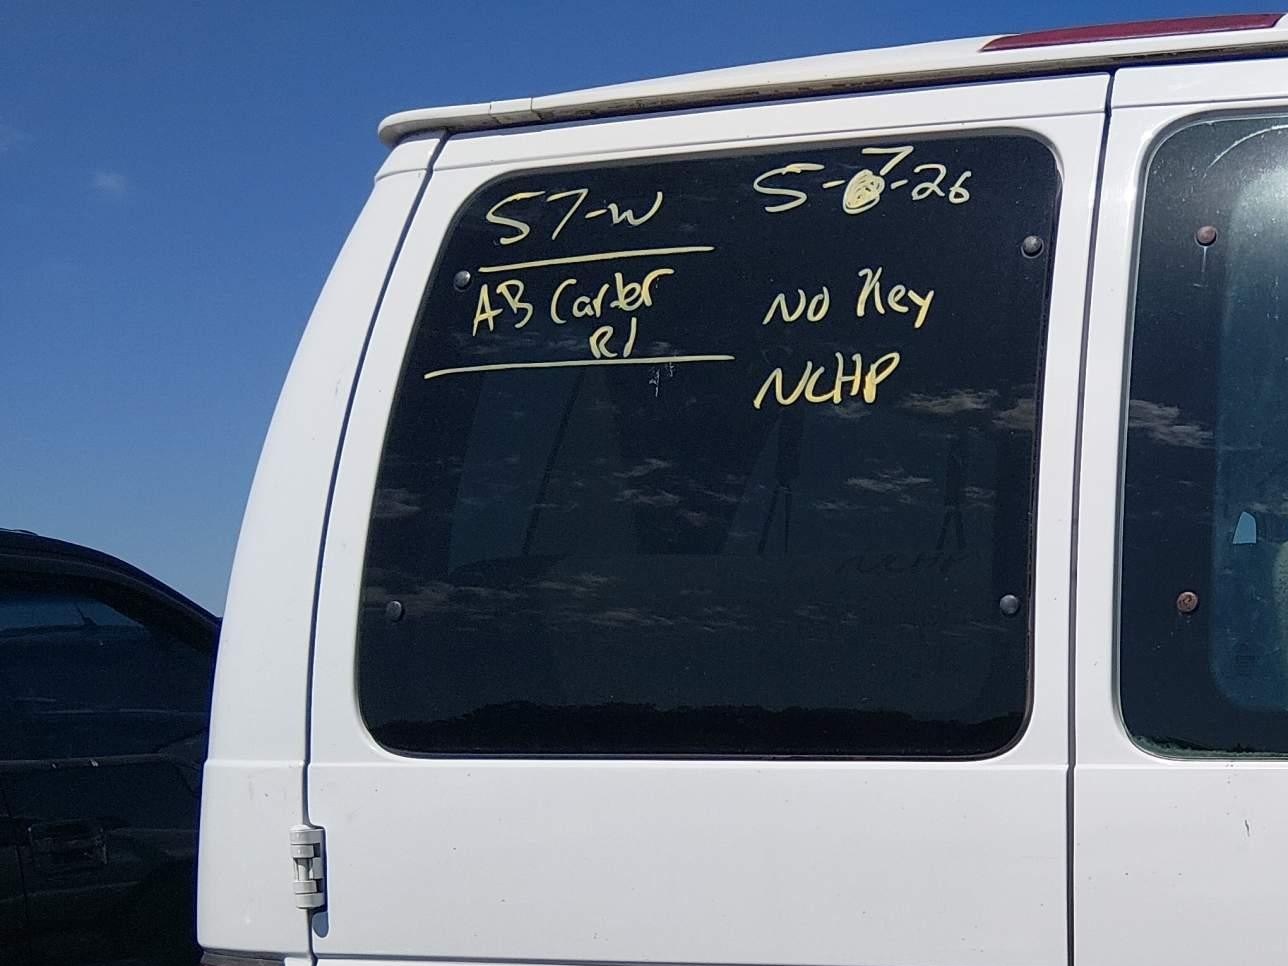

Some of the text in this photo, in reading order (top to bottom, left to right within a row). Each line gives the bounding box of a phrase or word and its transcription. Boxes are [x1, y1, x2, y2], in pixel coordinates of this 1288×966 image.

[472, 279, 534, 337] AB
[858, 267, 935, 328] Key
[754, 352, 900, 408] NCHP
